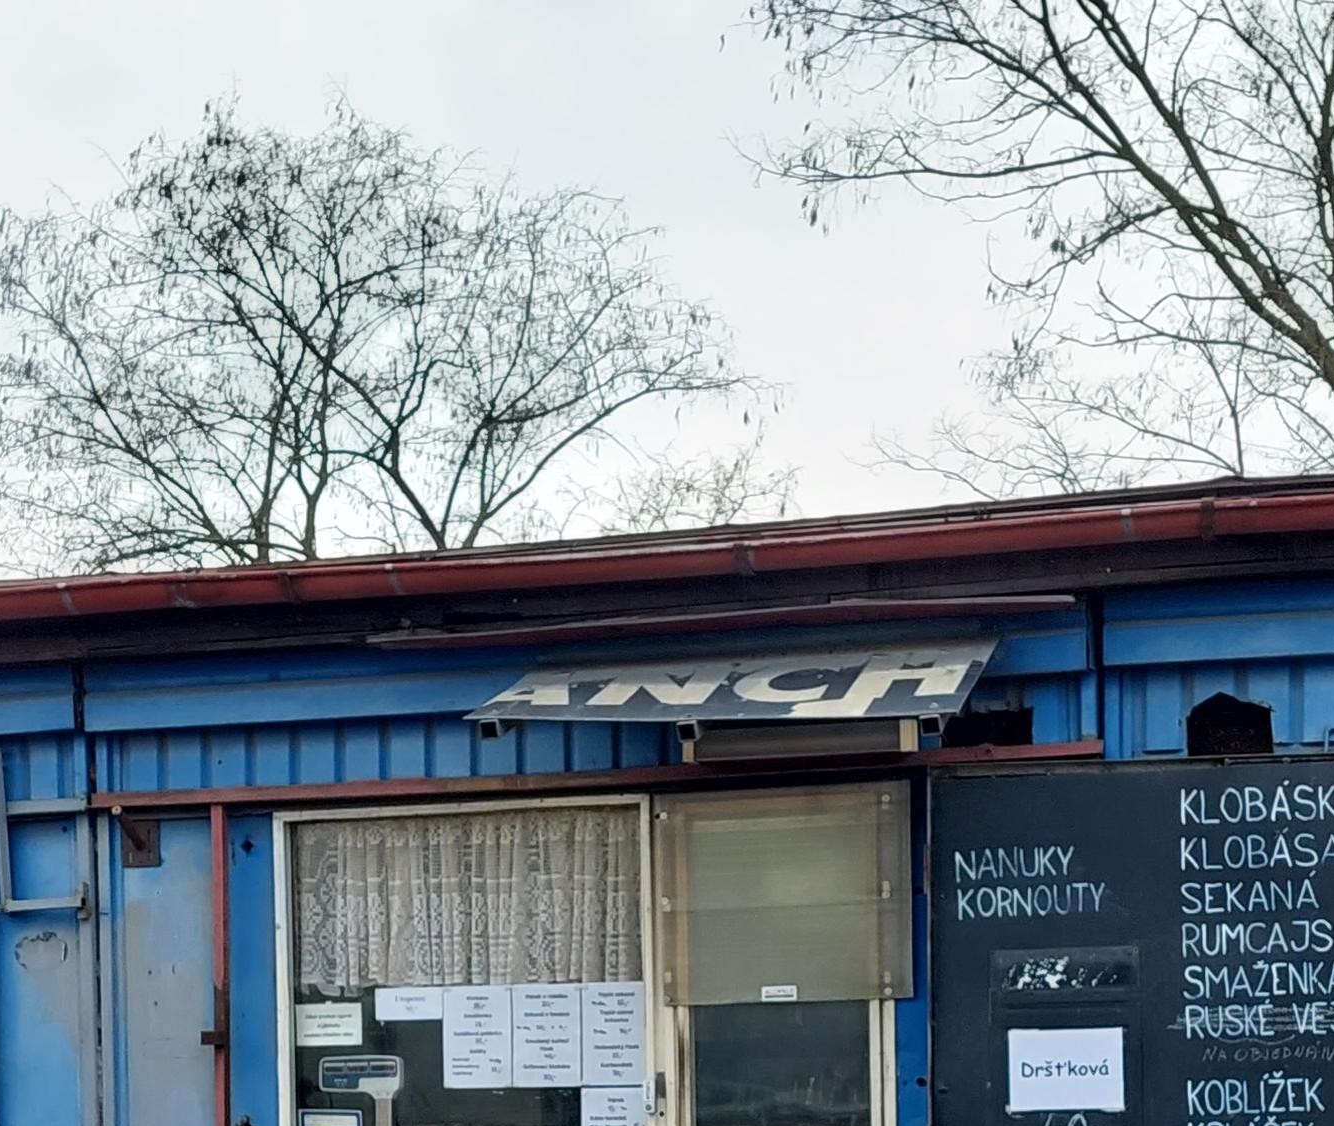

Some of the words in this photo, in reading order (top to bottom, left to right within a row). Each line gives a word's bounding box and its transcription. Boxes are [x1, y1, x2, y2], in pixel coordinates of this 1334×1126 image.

[954, 846, 1075, 883] NANUKY
[957, 882, 1105, 920] KORNOUTY
[1180, 871, 1320, 914] SEKANÁ
[1181, 919, 1334, 958] RUMCAJS
[1021, 1059, 1109, 1078] Dršťková
[1186, 1070, 1325, 1116] KOBLÍŽEK
